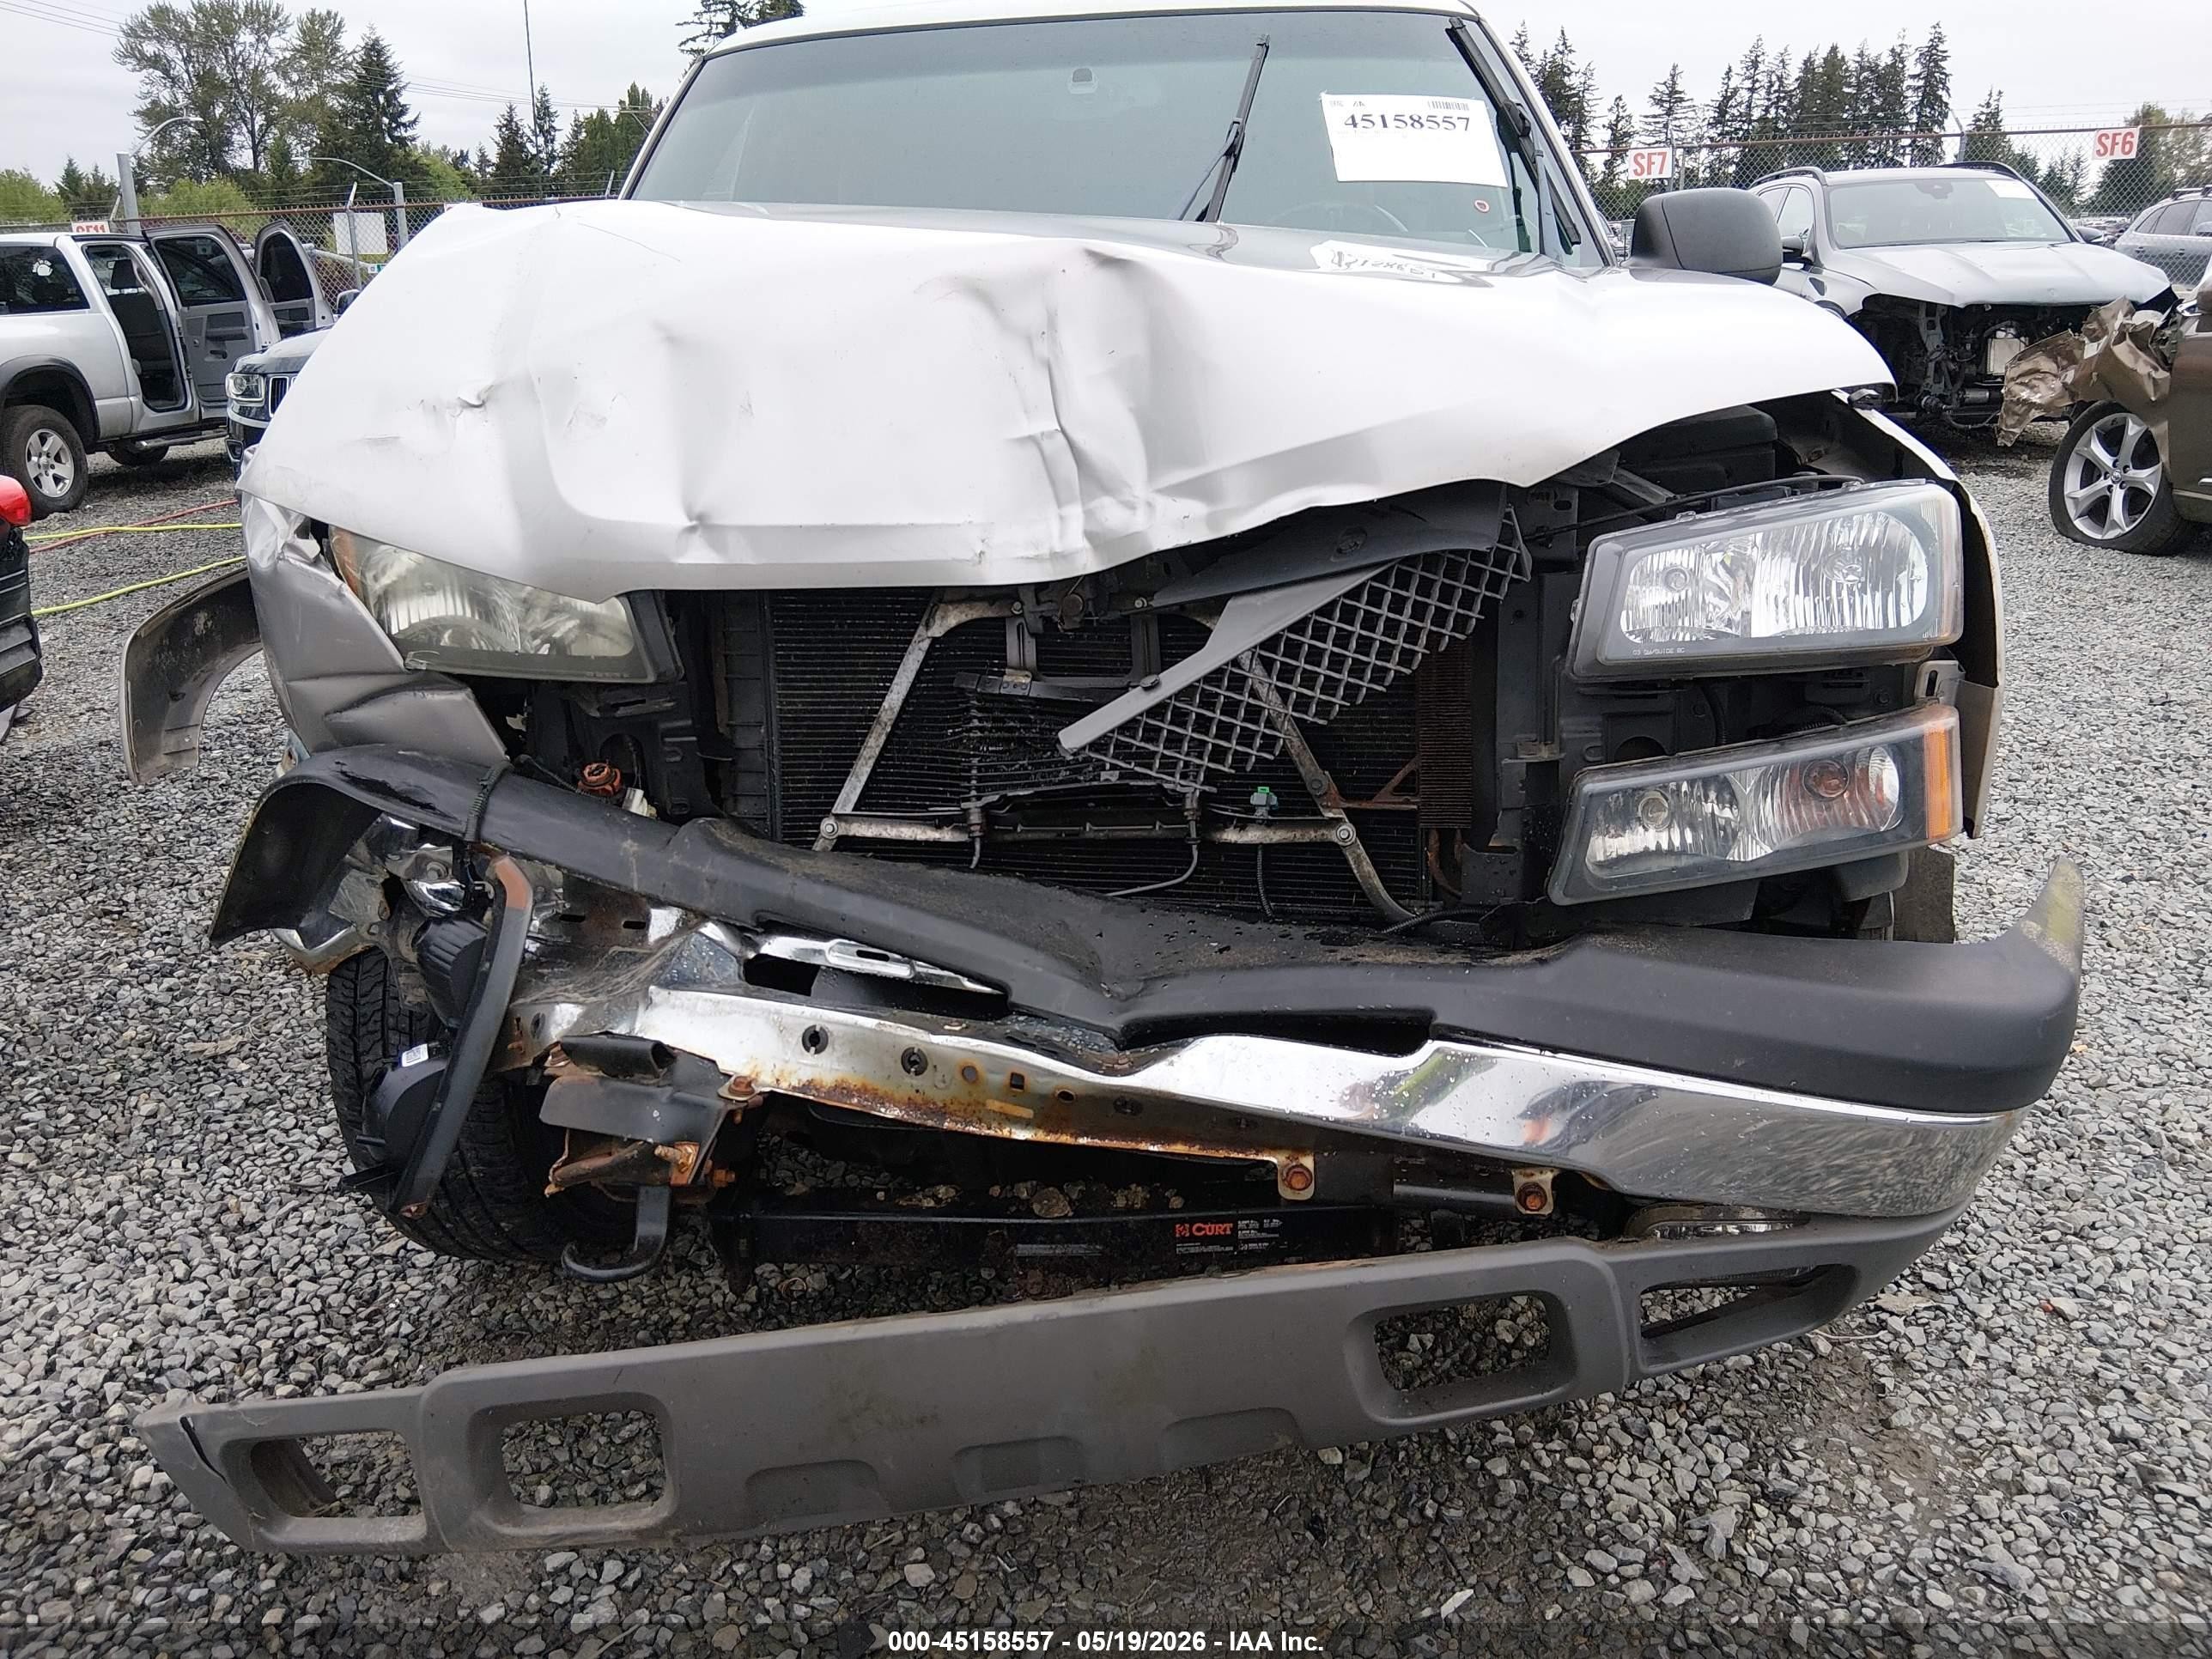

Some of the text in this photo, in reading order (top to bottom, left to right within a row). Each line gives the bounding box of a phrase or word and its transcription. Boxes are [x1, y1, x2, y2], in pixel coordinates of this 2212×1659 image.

[1344, 113, 1470, 131] 45158557
[2096, 131, 2135, 157] SF6
[1633, 151, 1668, 176] SF7
[1192, 1223, 1233, 1236] CURT
